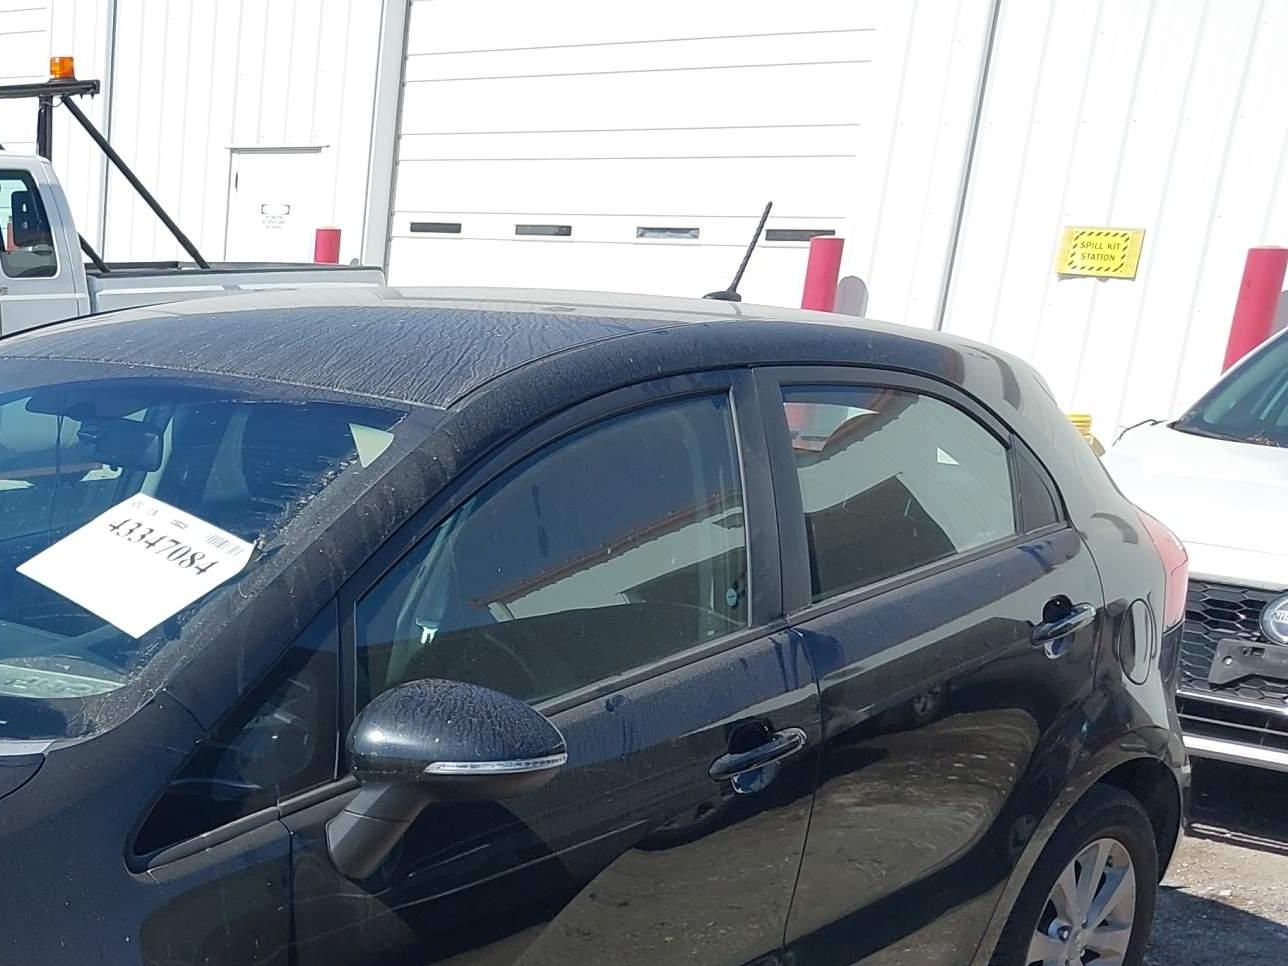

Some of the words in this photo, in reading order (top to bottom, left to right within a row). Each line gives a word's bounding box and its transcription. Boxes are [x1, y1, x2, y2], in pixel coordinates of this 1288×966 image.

[1080, 241, 1103, 250] SPILL
[1080, 252, 1116, 261] STATION
[108, 518, 219, 576] 43347084
